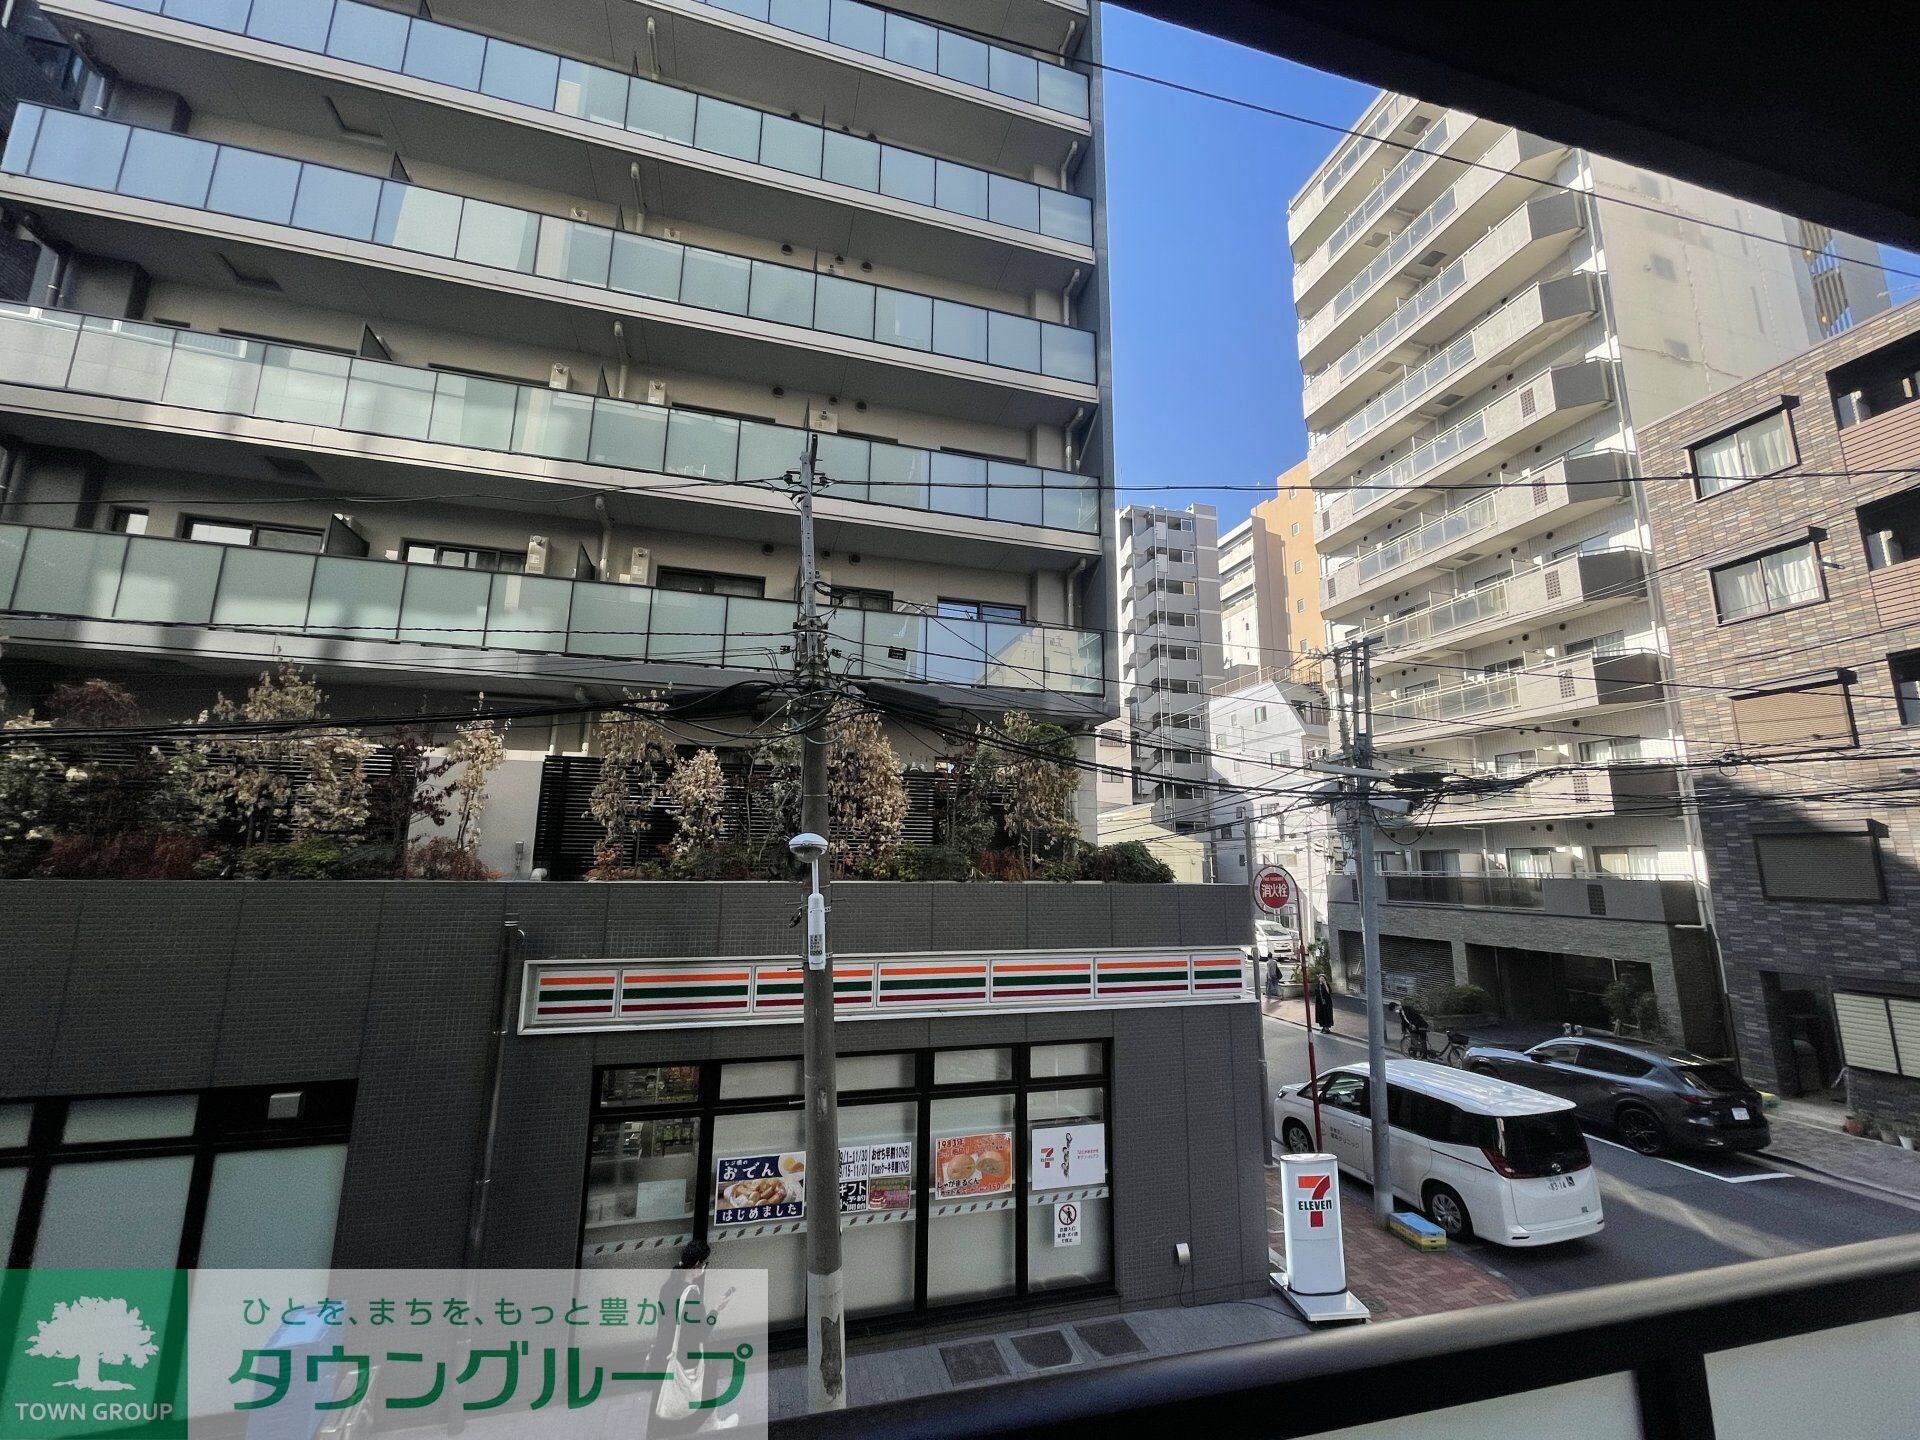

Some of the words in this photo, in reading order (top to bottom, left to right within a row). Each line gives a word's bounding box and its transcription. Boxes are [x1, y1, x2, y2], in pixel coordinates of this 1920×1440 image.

[1261, 883, 1288, 898] 消火栓
[723, 1162, 774, 1180] おでん
[722, 1204, 797, 1221] はじめました
